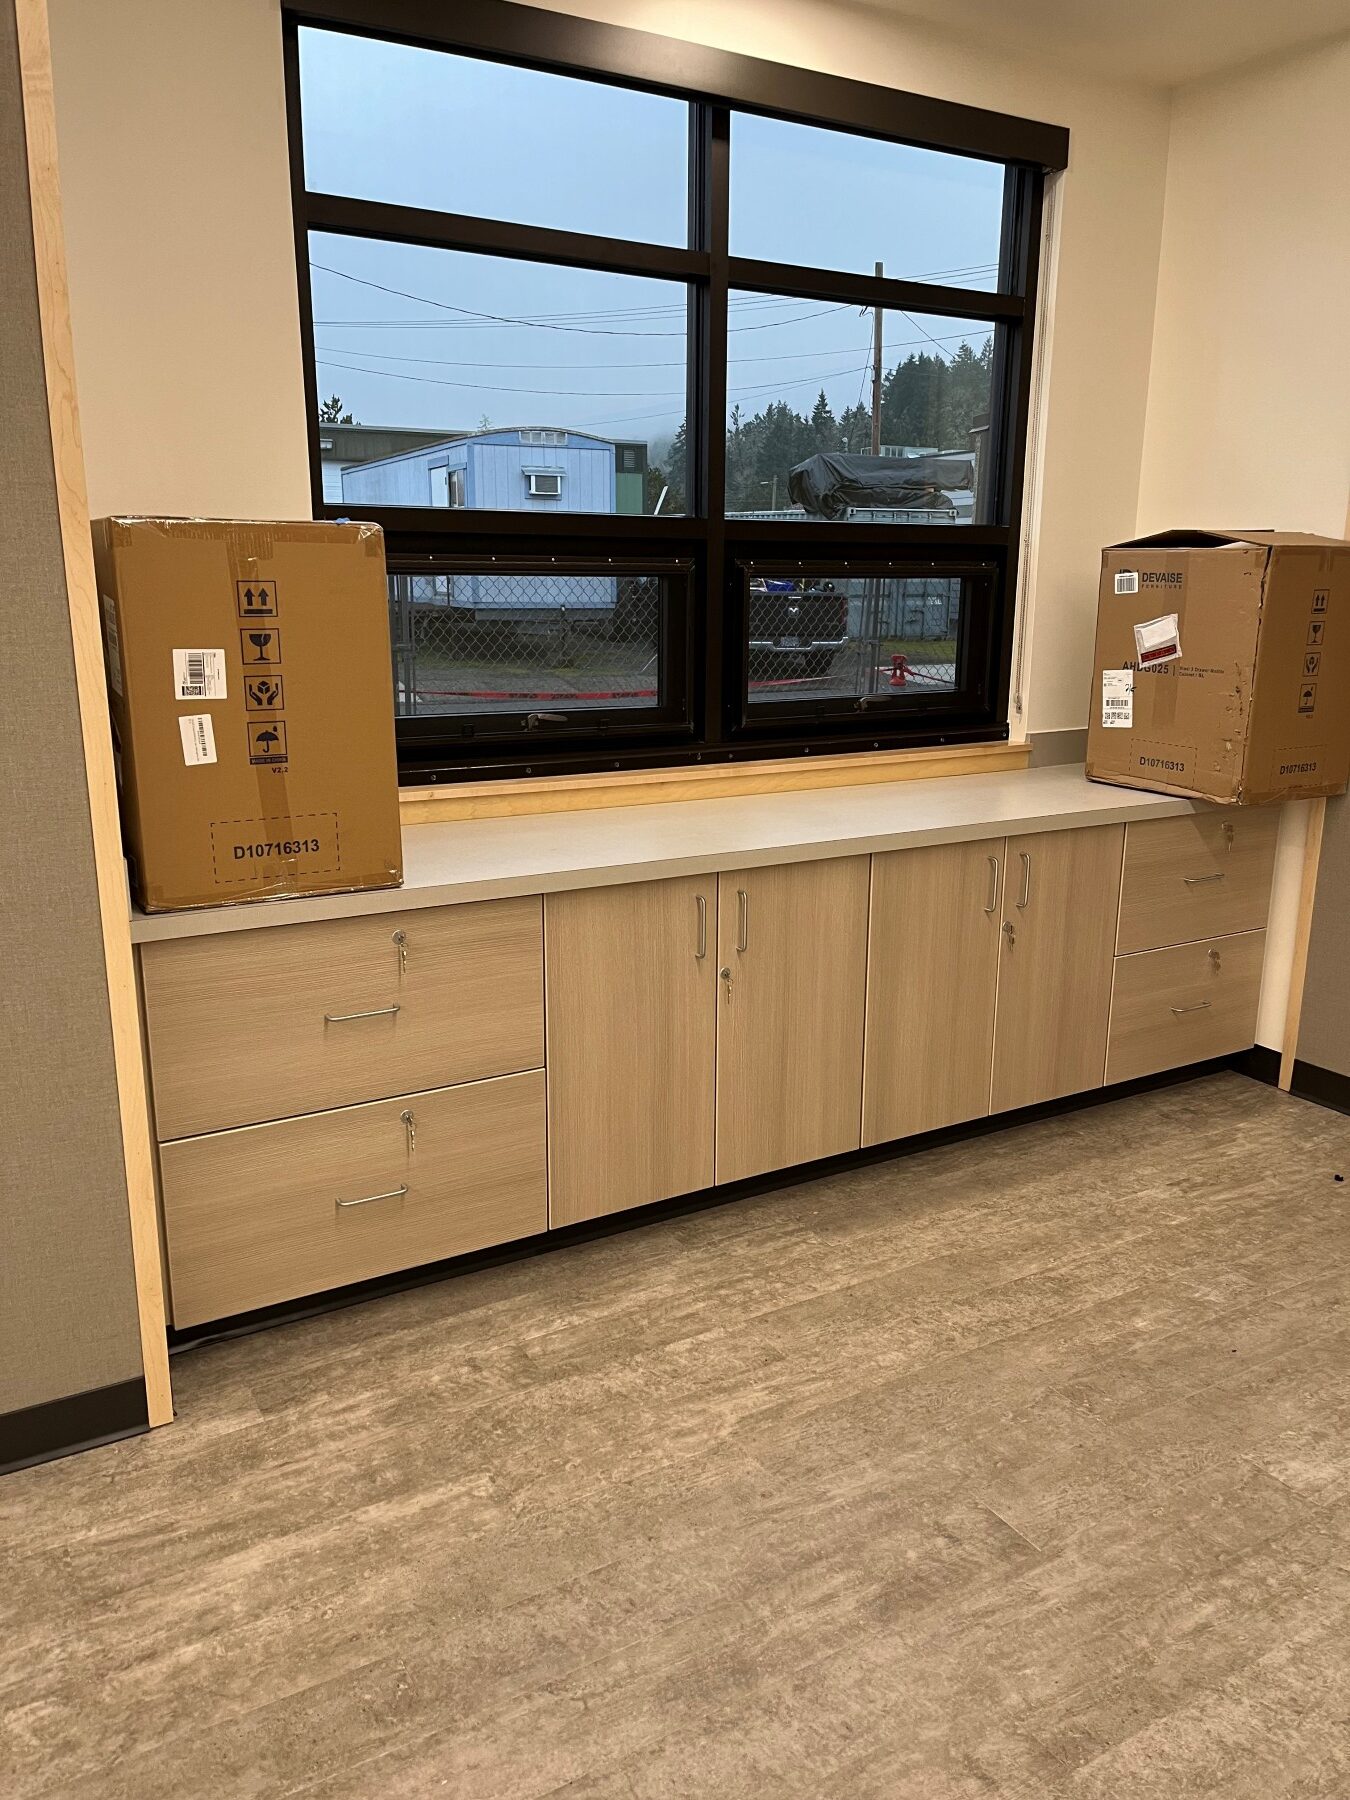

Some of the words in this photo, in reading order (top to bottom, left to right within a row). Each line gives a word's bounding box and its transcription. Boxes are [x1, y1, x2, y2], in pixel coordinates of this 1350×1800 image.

[1142, 572, 1183, 583] DEVAISE
[1139, 756, 1185, 772] D10716313
[1280, 762, 1317, 776] D10716313
[233, 839, 320, 860] D10716313
